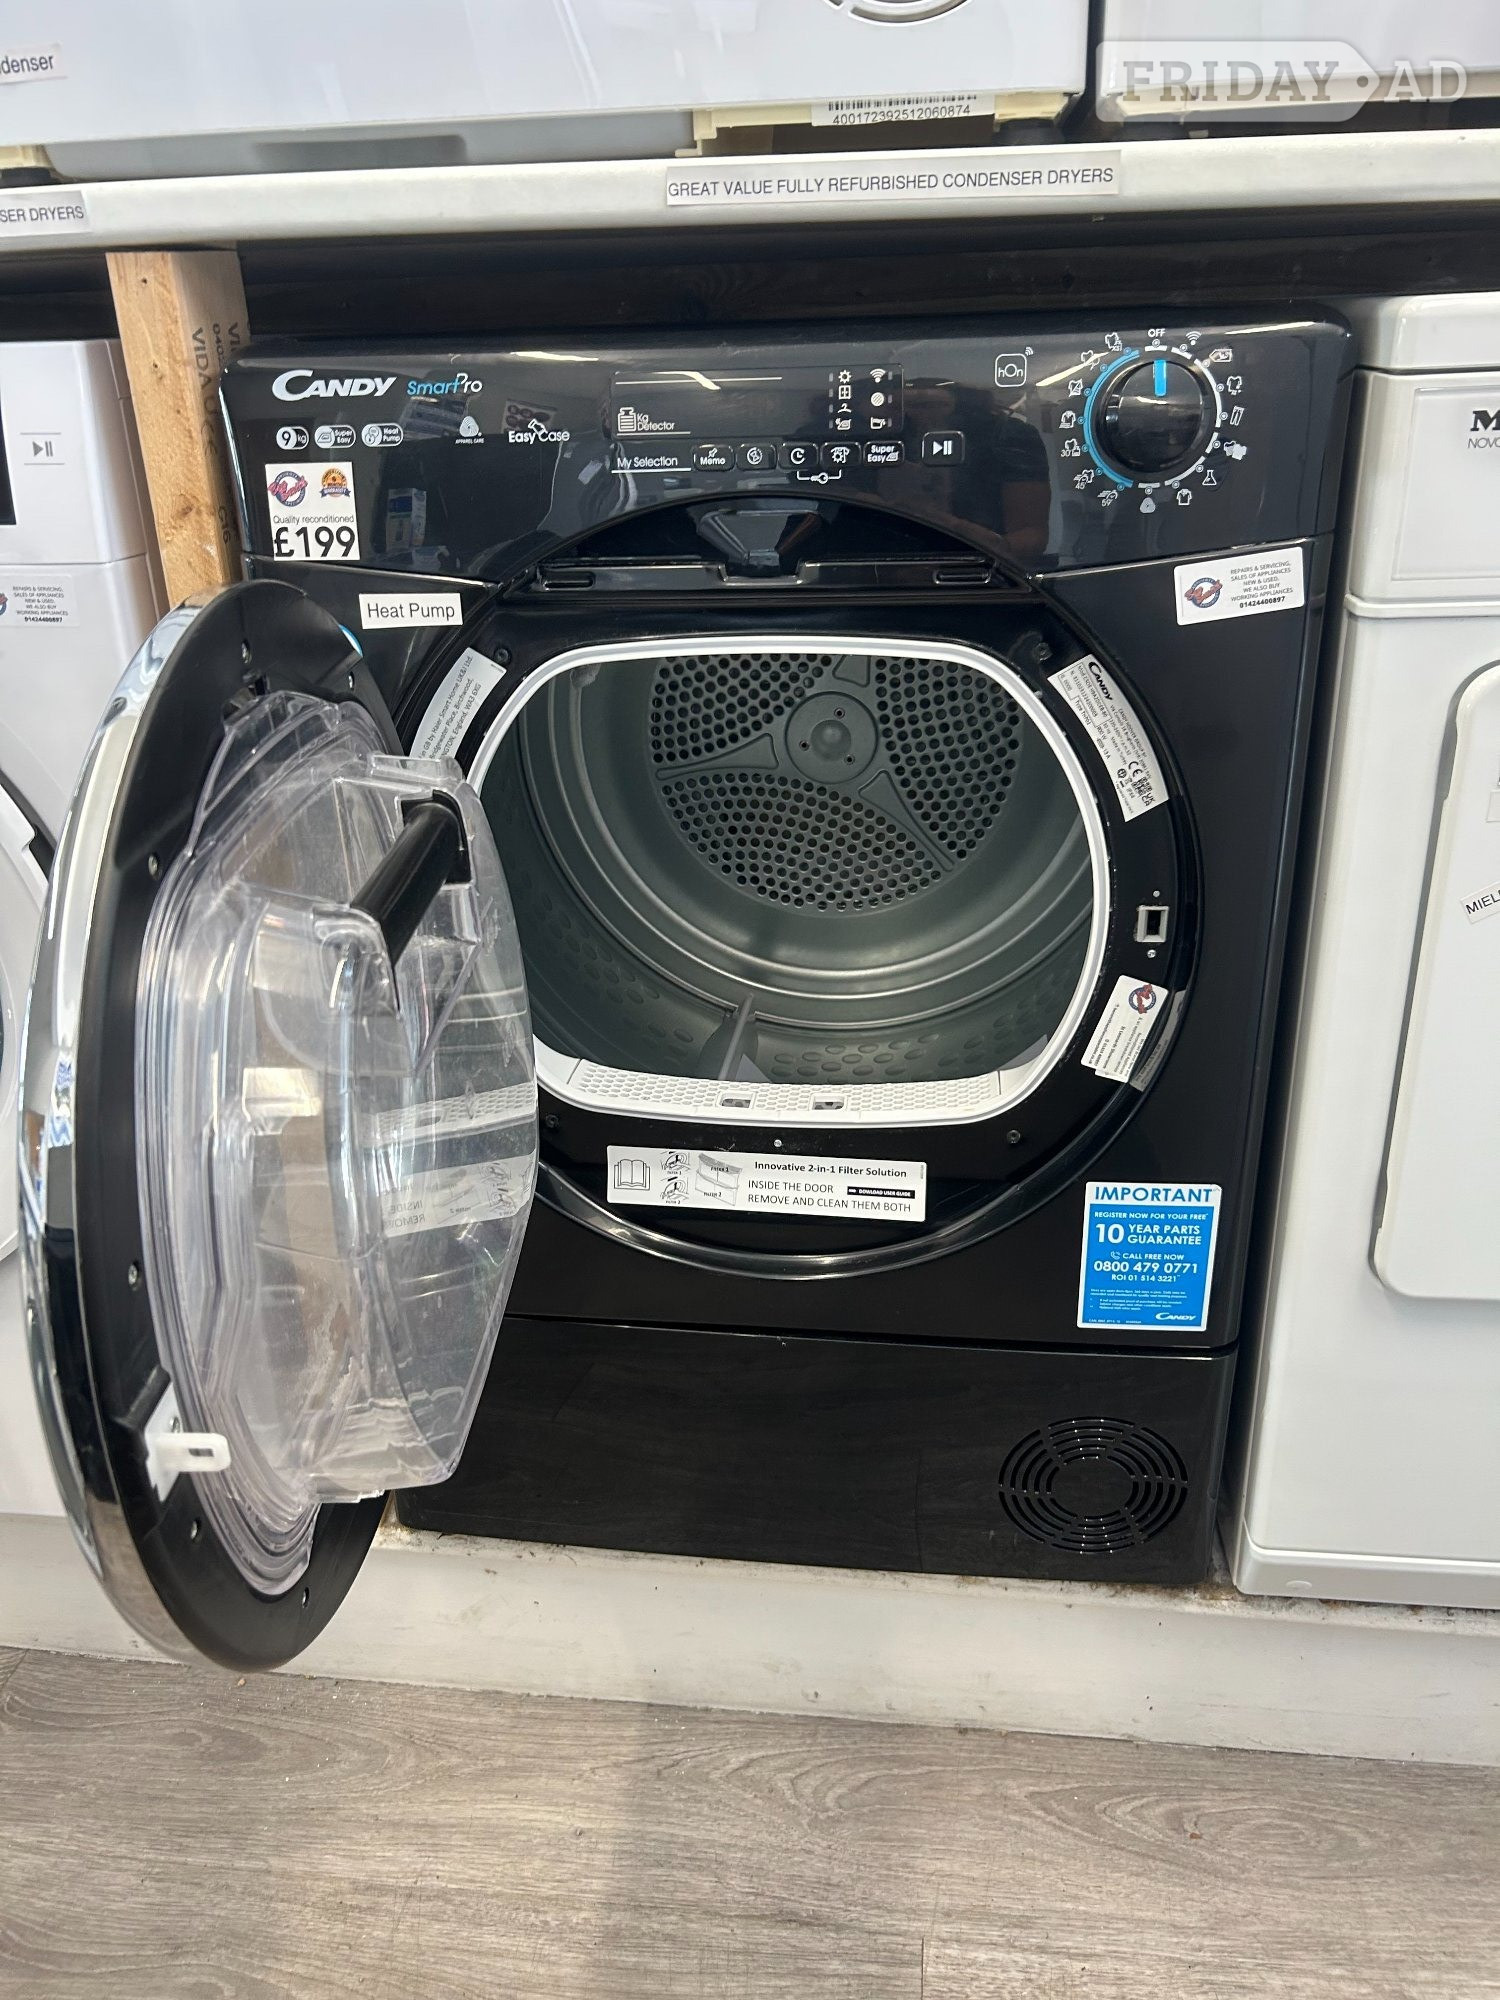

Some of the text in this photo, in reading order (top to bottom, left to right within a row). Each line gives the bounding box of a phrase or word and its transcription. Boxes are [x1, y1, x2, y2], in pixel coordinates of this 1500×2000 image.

[0, 54, 54, 76] denser
[668, 168, 1113, 197] GREAT VALUE FULLY REFURBISHED CONDENSER DRYERS
[29, 205, 84, 222] DRYERS
[1147, 328, 1166, 338] OFF
[272, 369, 398, 402] CANDY
[637, 413, 649, 424] Kg
[637, 421, 675, 431] Detector
[282, 430, 291, 446] 9
[870, 444, 895, 454] Super
[618, 456, 678, 470] My Selection
[700, 456, 726, 466] Memo
[867, 454, 886, 464] Easy
[273, 514, 355, 525] Quality reconditioned
[274, 526, 356, 558] £199
[1240, 596, 1286, 608] 01424400897
[367, 602, 455, 622] Heat Pump
[1089, 662, 1113, 701] CANDY
[440, 700, 449, 718] Smart
[448, 683, 460, 700] Home
[1466, 889, 1500, 914] MIEL
[755, 1162, 906, 1178] Innovative 2-in-1 Filter Solution
[748, 1180, 834, 1194] INSIDE THE DOOR
[1094, 1186, 1212, 1202] IMPORTANT
[748, 1194, 910, 1212] REMOVE AND CLEAN THEM BOTH
[1096, 1223, 1200, 1244] 10 YEAR PARTS
[1128, 1234, 1202, 1245] GUARANTEE
[1122, 1252, 1142, 1260] CALL
[1094, 1260, 1198, 1274] 0800 479 0771
[1140, 1274, 1155, 1282] 514
[1155, 1312, 1196, 1321] CANDY
